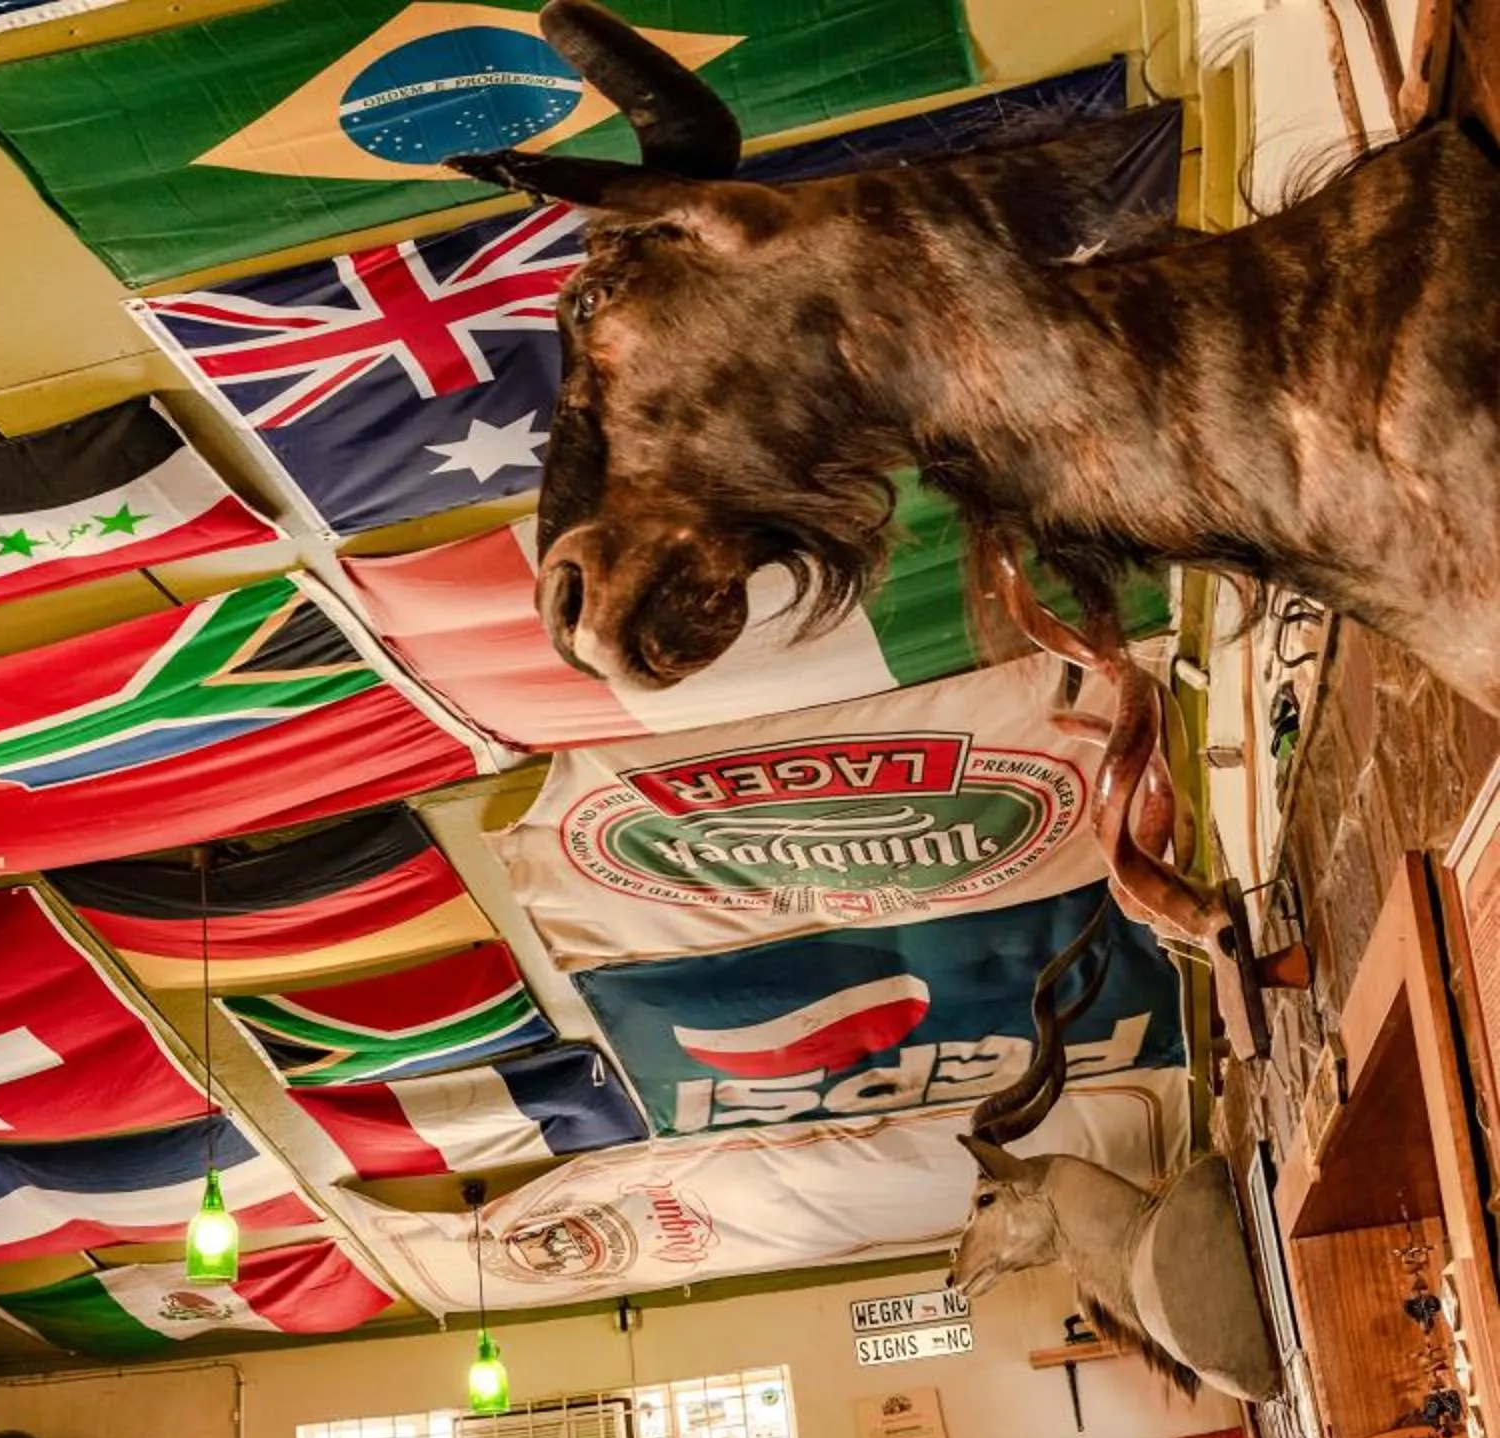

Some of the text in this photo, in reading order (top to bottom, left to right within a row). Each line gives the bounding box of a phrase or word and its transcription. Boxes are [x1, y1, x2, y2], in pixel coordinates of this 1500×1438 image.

[670, 750, 926, 803] LAGER
[654, 820, 1000, 877] Windhoek
[859, 1327, 971, 1363] SIGNS NC
